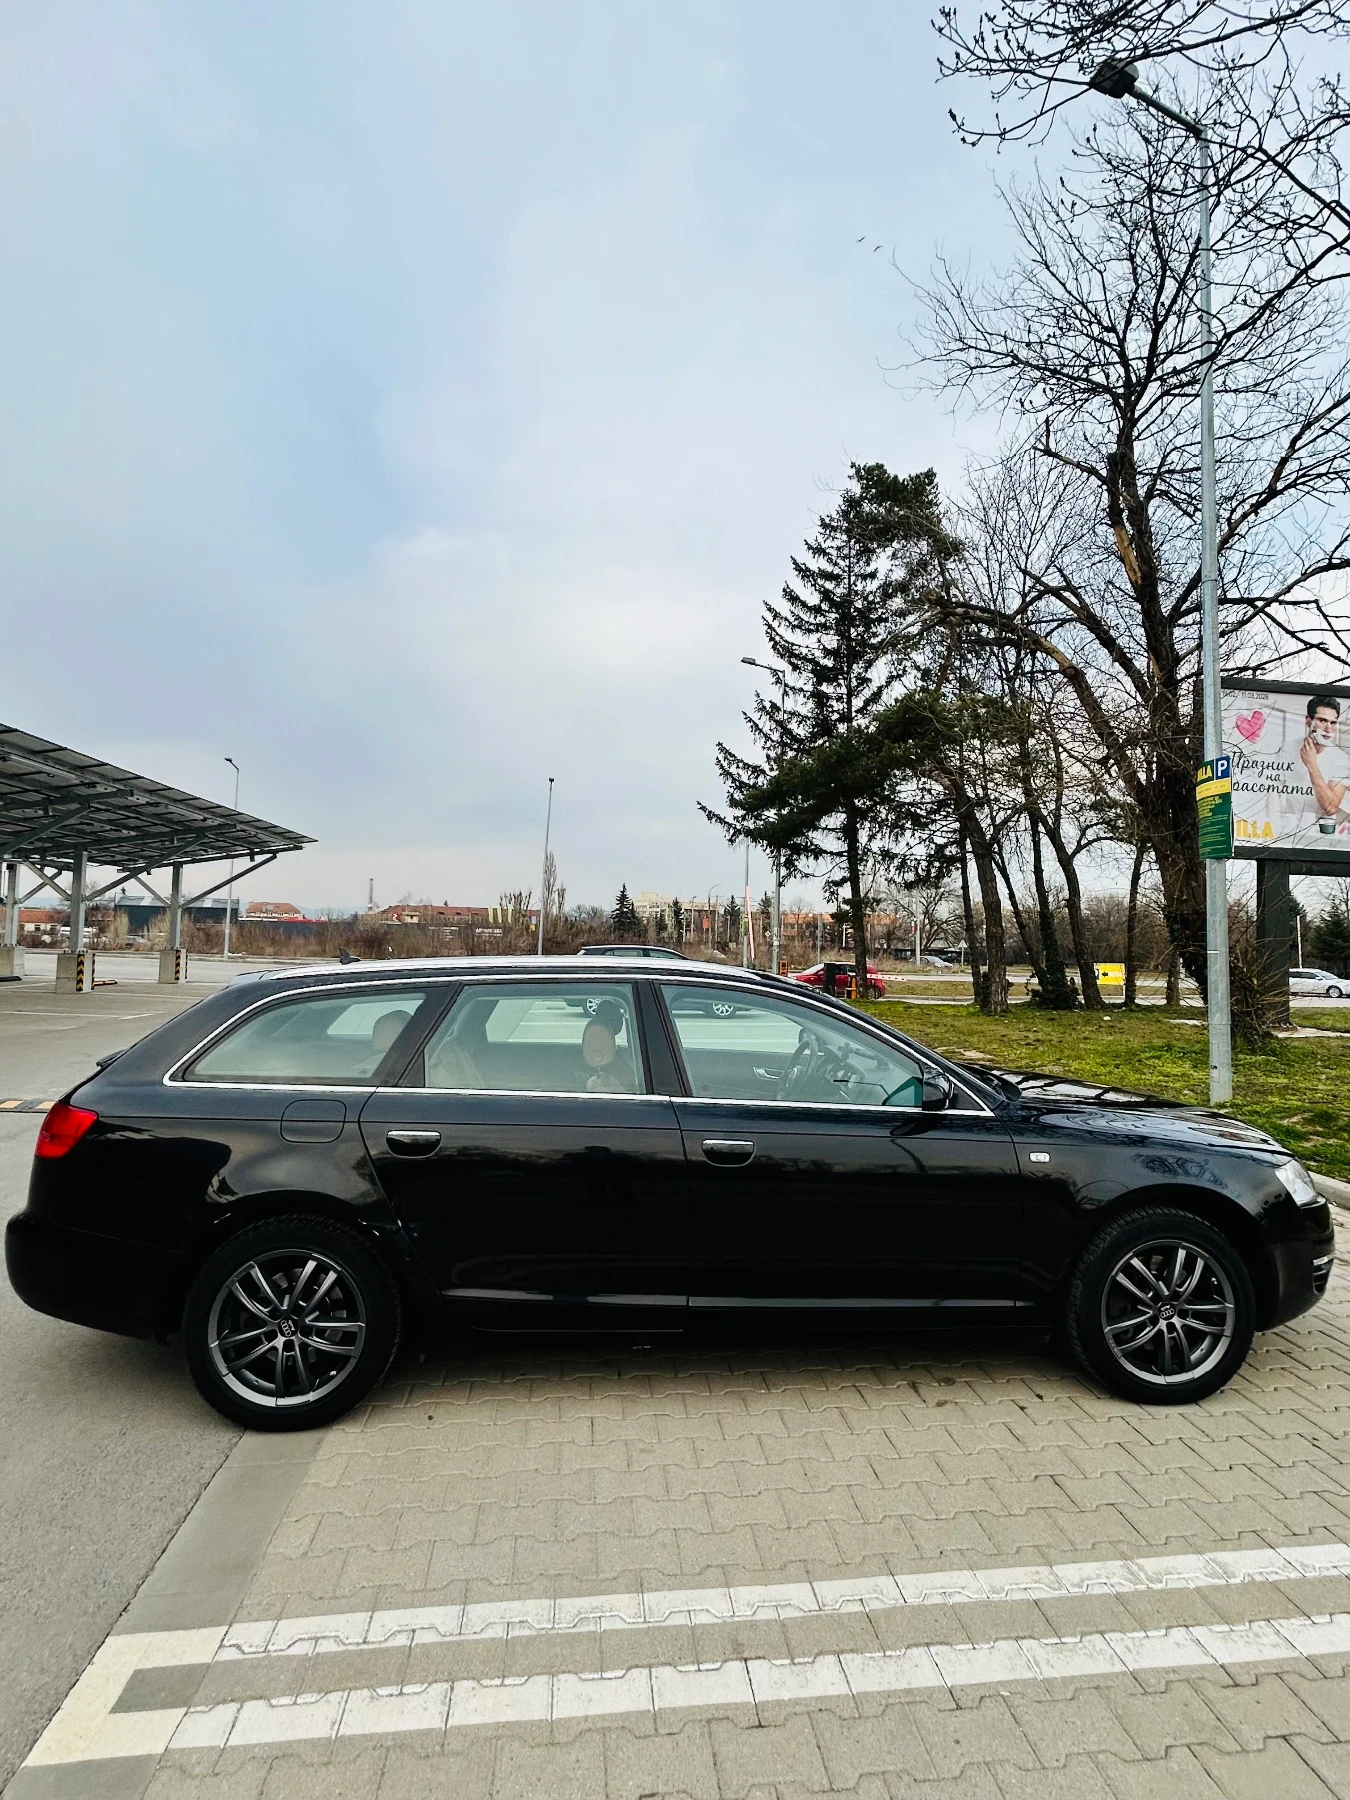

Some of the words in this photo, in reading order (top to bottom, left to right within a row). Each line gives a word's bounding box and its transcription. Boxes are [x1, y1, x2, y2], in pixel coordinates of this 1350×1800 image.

[1197, 765, 1212, 782] ILLA
[1217, 759, 1228, 777] P
[1231, 750, 1294, 778] Празник
[1266, 773, 1281, 782] на
[1232, 781, 1314, 797] расотата
[1235, 819, 1275, 840] ILLA
